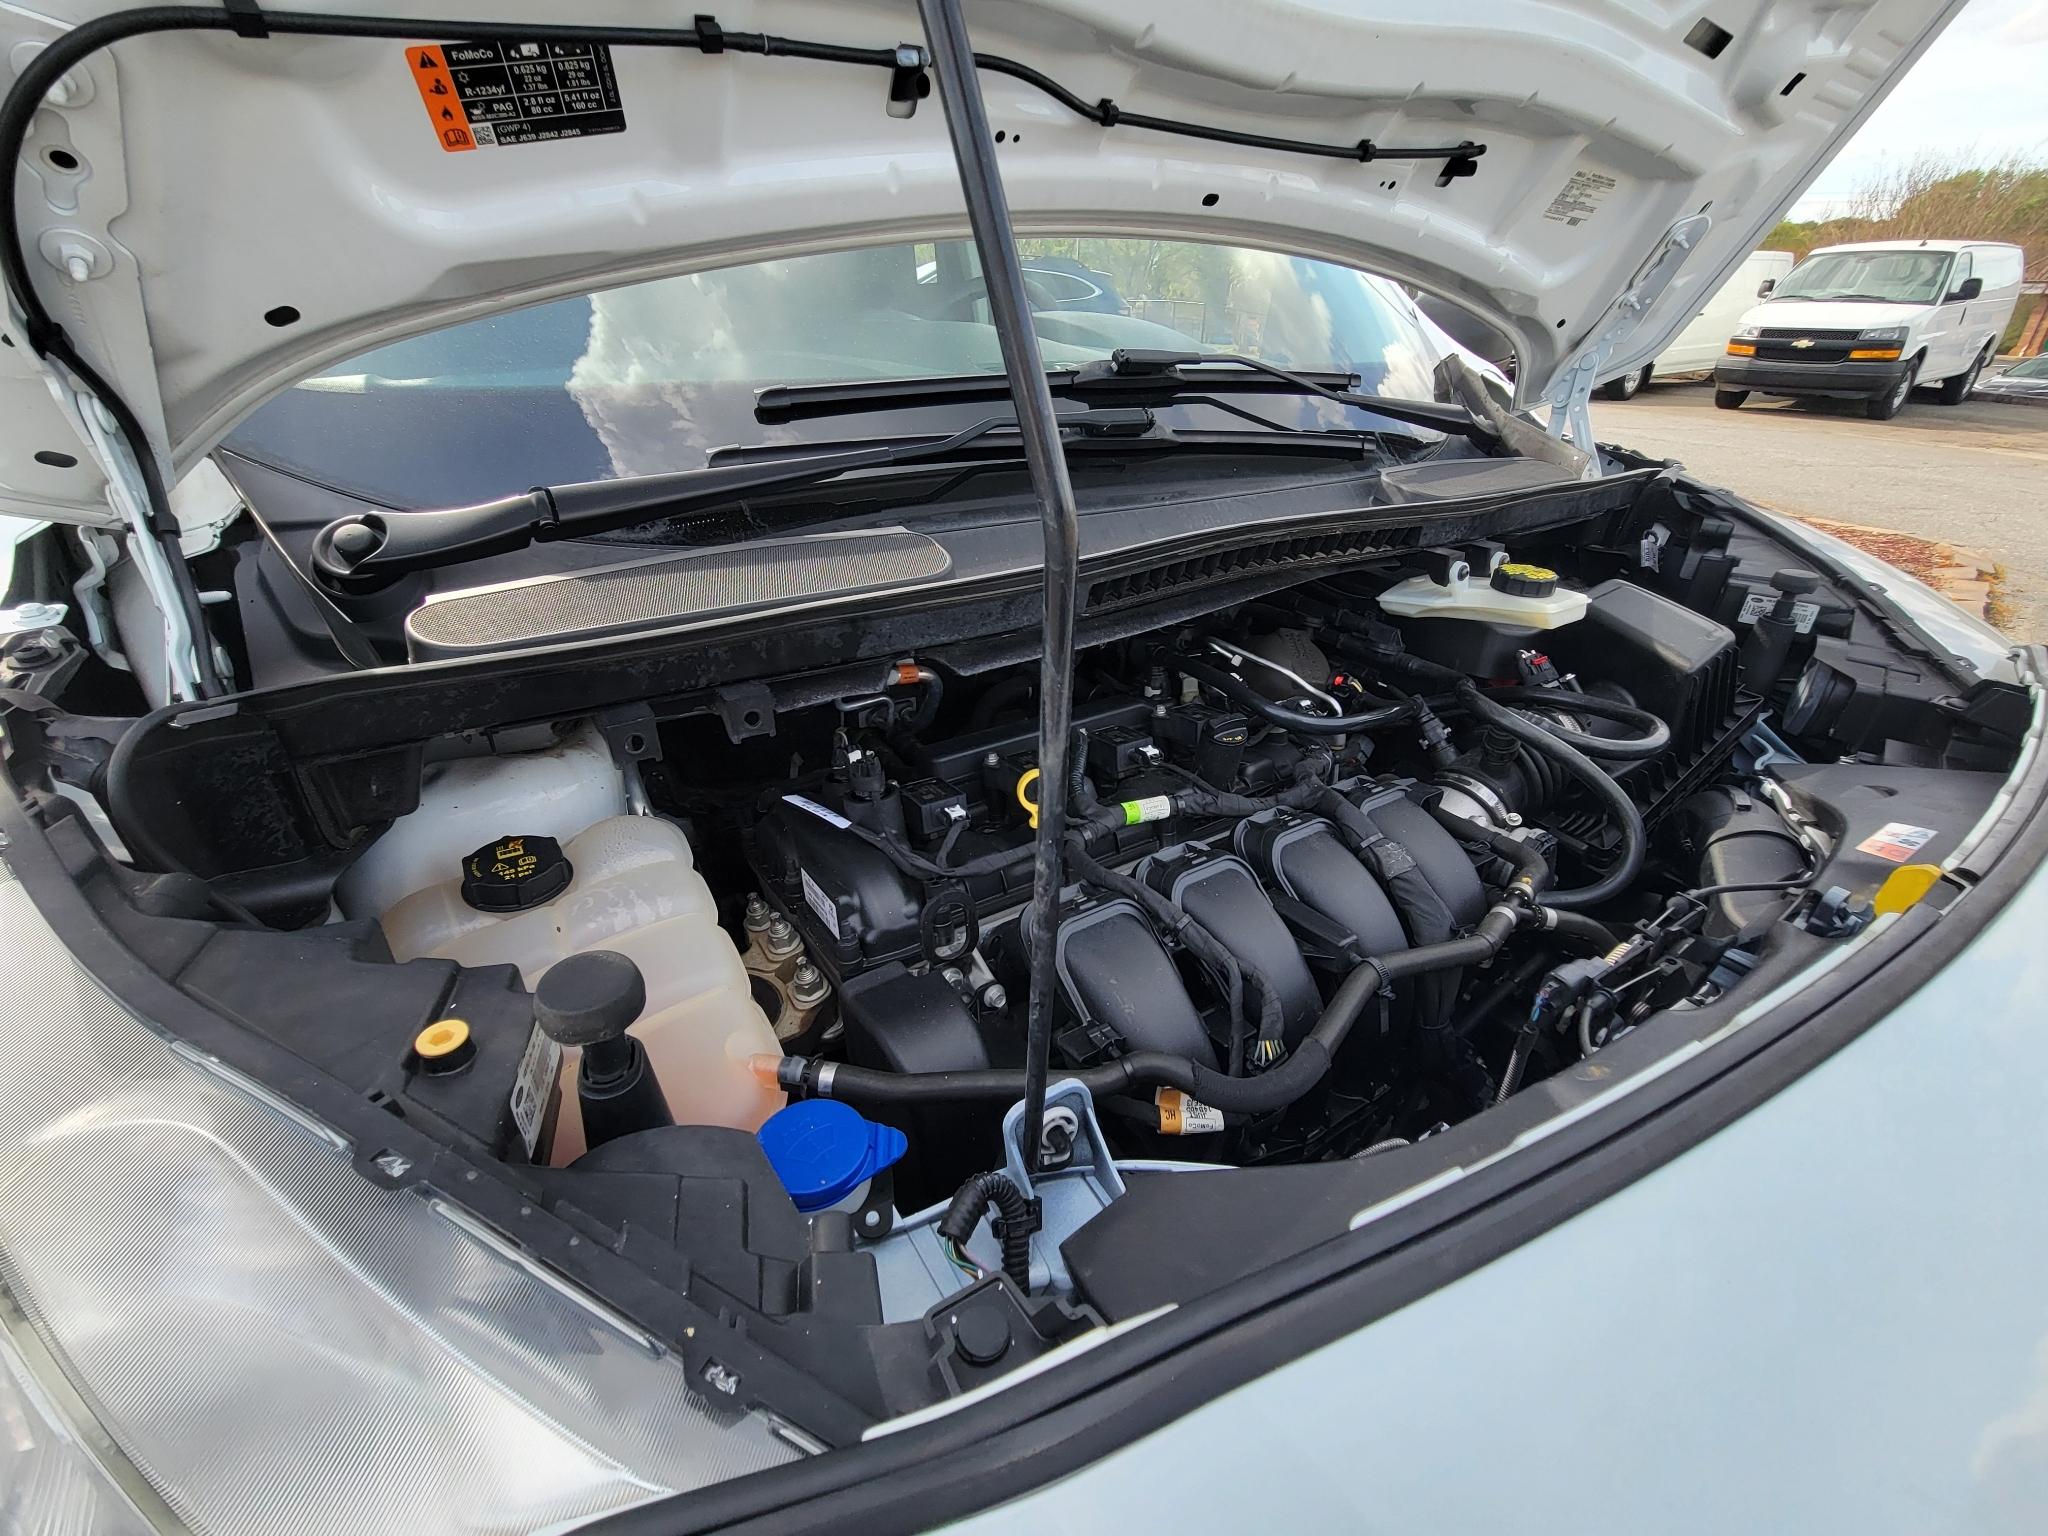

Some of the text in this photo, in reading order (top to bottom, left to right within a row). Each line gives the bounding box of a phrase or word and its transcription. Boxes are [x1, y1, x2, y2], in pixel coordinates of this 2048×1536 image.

[451, 48, 494, 61] FoMoCo
[513, 64, 547, 75] 0.625 kg
[558, 60, 591, 71] 0.825 kg
[524, 75, 532, 83] 22
[567, 71, 576, 79] 29
[464, 84, 506, 97] R-1234yf
[523, 83, 536, 92] 1.37
[523, 96, 556, 106] 2.8 fl oz
[564, 92, 581, 102] 5.41
[582, 92, 589, 100] fl
[493, 102, 514, 112] PAG
[531, 105, 554, 115] 80 cc
[571, 101, 586, 110] 160
[497, 122, 532, 133] (GWP 4)
[500, 133, 518, 144] SAE
[518, 132, 537, 143] J639
[537, 130, 559, 141] J2842
[560, 128, 581, 138] J2845
[517, 864, 536, 873] kPa
[518, 869, 533, 878] psi
[1165, 1109, 1177, 1121] HC
[1187, 1122, 1214, 1130] FoMoCo
